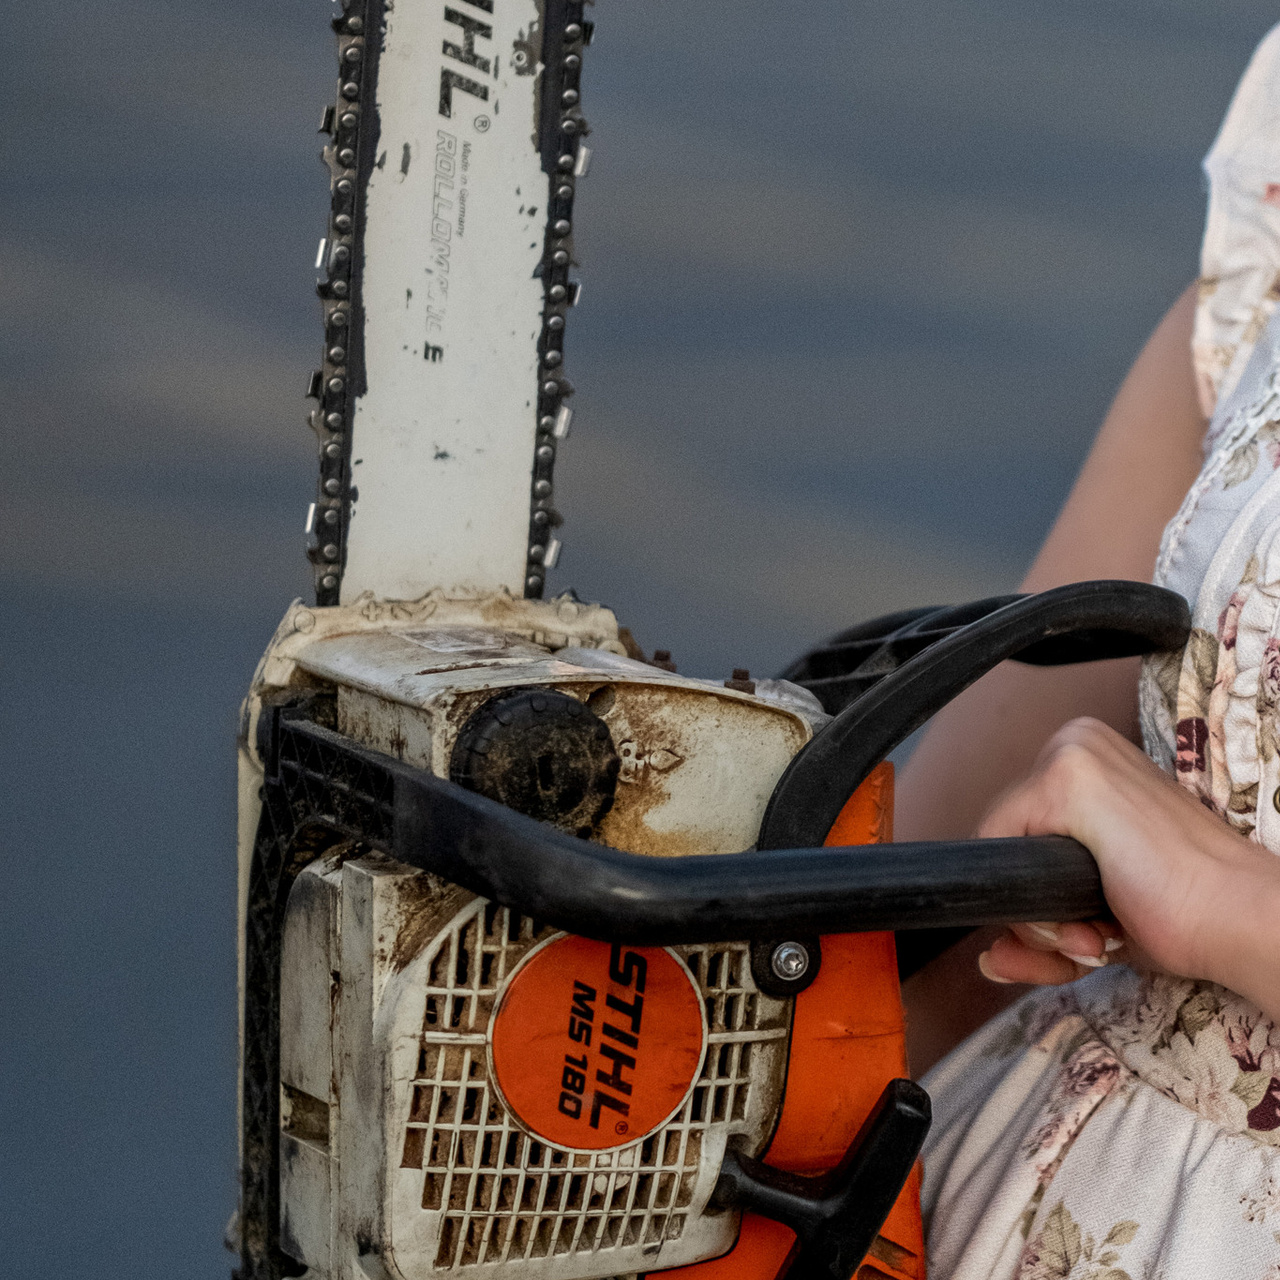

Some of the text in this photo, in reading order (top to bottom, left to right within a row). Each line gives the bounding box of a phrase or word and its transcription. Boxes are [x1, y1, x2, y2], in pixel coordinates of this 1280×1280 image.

[461, 140, 471, 171] Made
[456, 187, 469, 238] Germany
[424, 341, 443, 363] E
[558, 980, 597, 1120] MS 180
[588, 942, 648, 1130] STIHL
